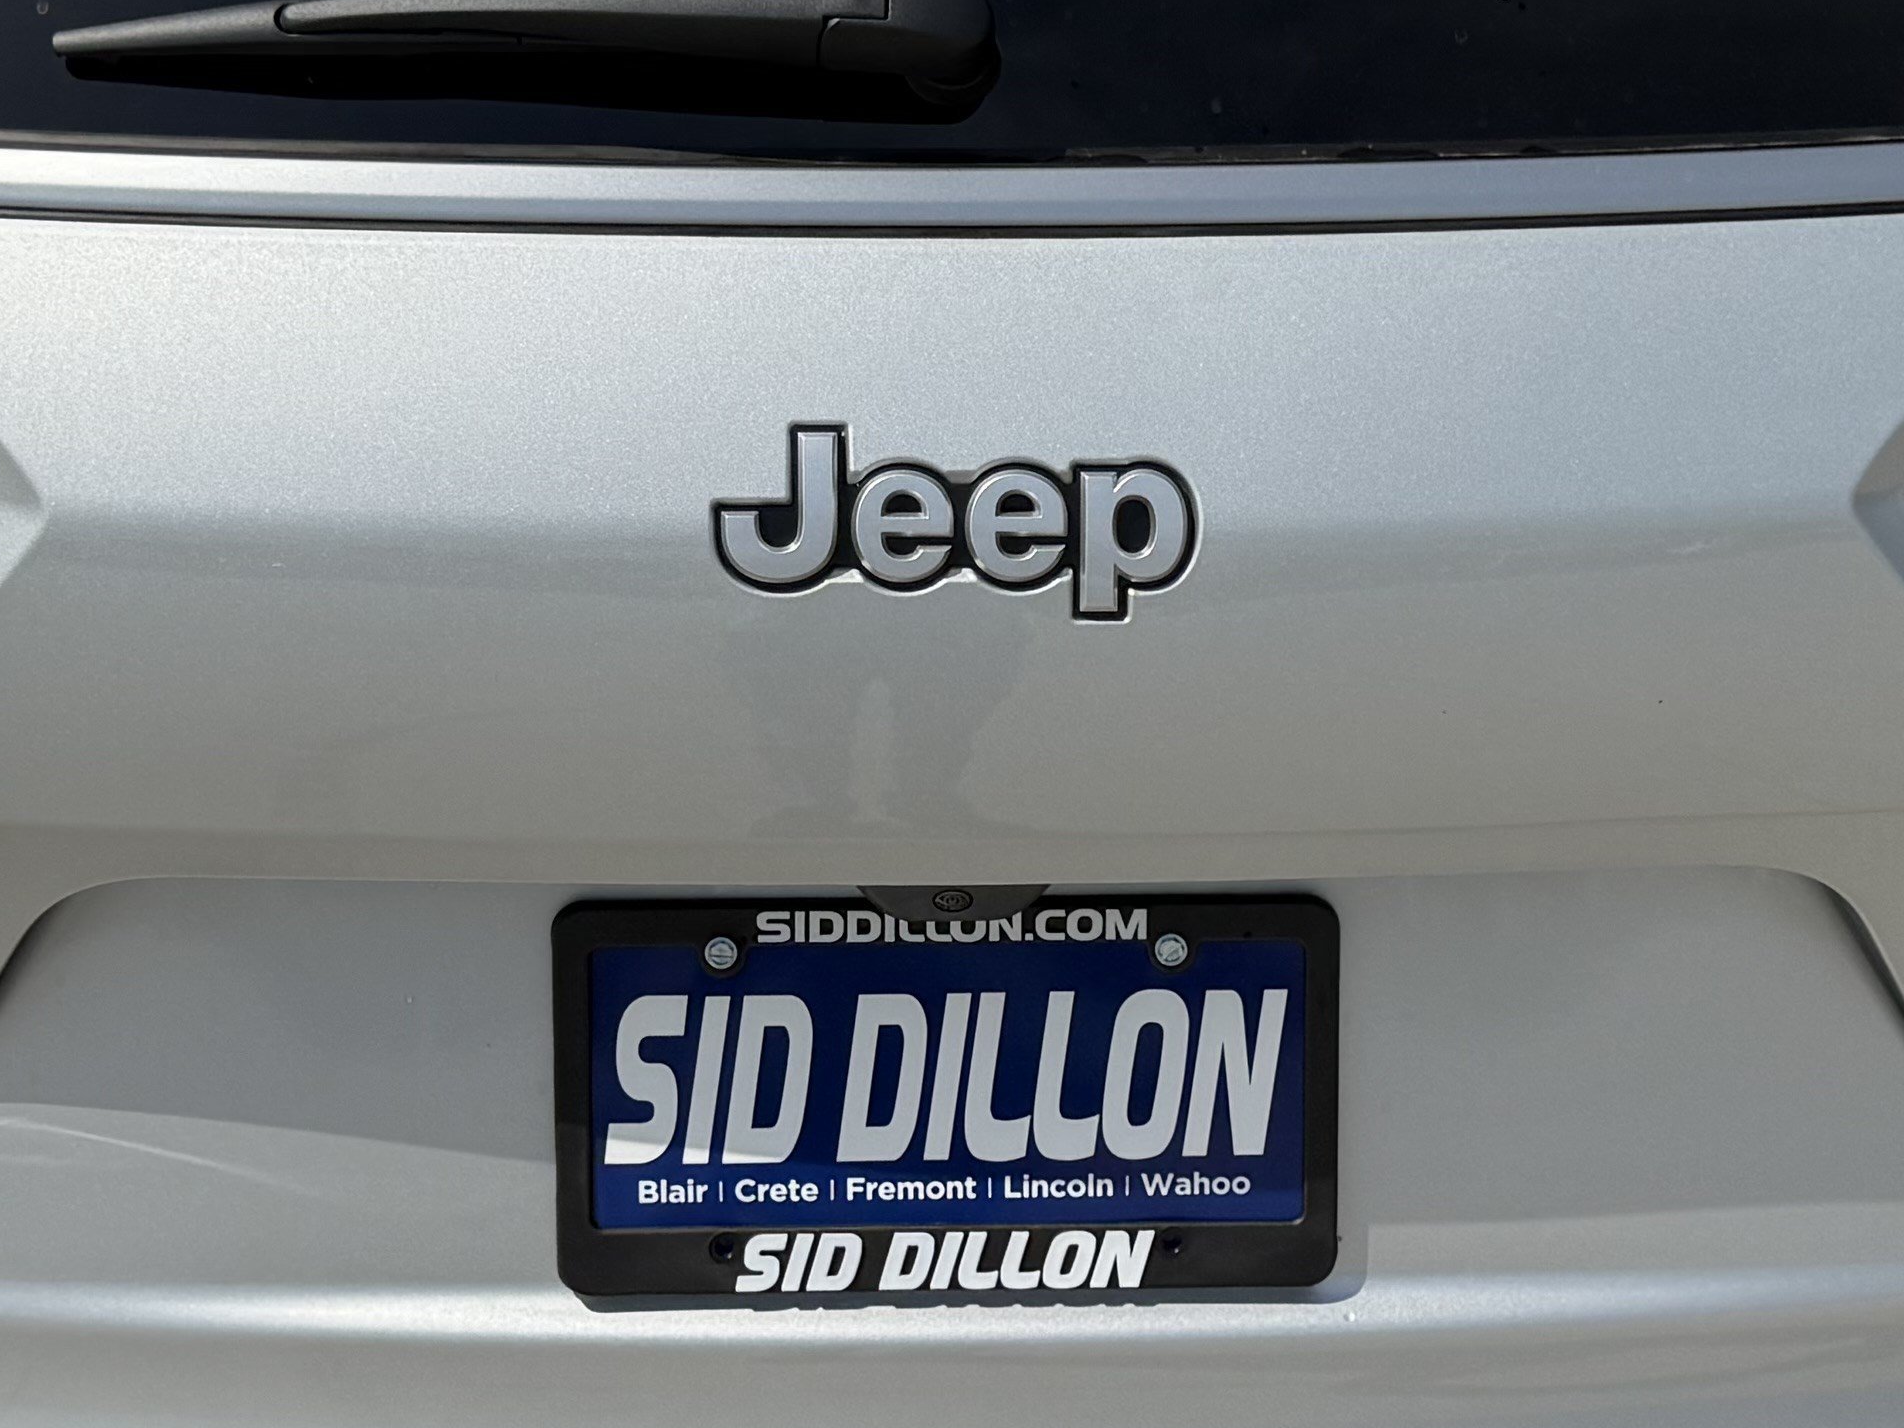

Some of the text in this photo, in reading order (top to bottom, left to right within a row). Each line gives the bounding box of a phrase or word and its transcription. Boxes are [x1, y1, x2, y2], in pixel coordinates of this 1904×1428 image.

[713, 424, 1197, 622] Jeep
[755, 908, 1148, 944] SIDDILLON.COM
[602, 988, 1289, 1166] SID DILLON
[637, 1172, 1251, 1204] Blair Crete Fremont Lincoln Wahoo
[734, 1229, 1156, 1293] SID DILLON
